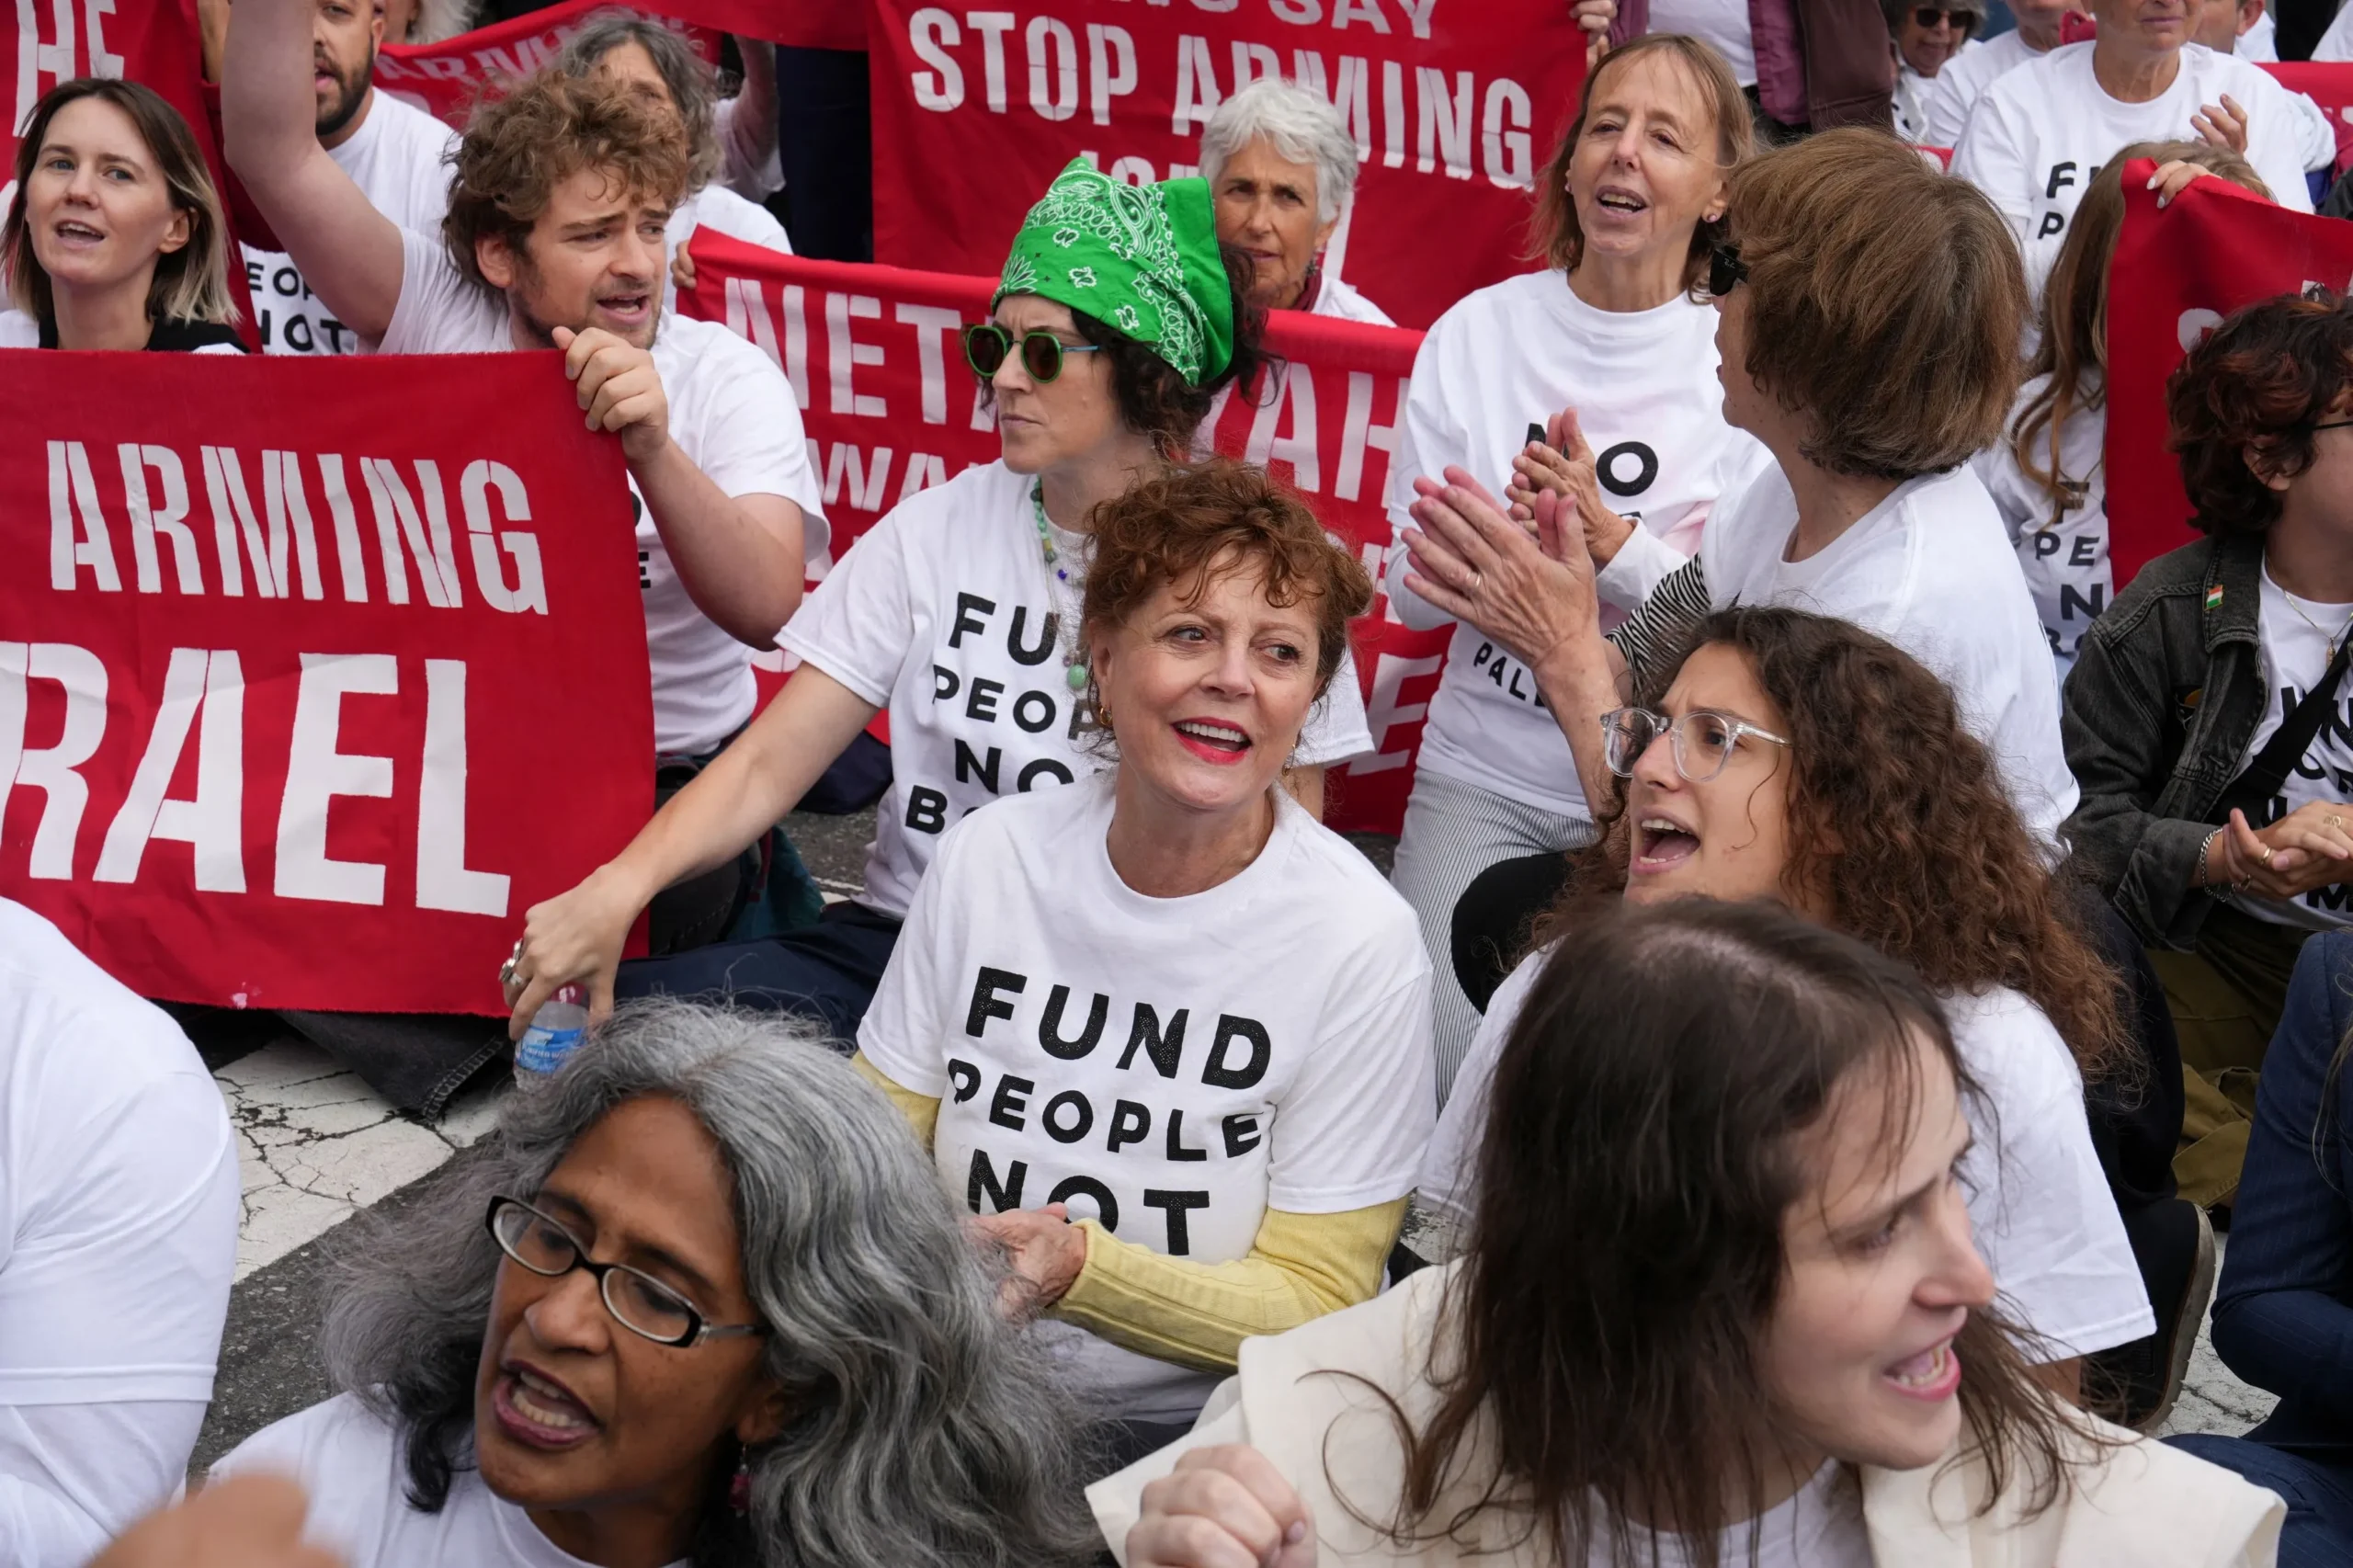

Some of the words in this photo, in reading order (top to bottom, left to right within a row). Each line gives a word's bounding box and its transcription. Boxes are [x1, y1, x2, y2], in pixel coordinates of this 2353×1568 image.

[909, 7, 1139, 126] STOP
[47, 440, 549, 615] ARMING
[954, 738, 1110, 796] NO
[965, 966, 1272, 1091] FUND
[947, 1058, 1262, 1163] PEOPLE
